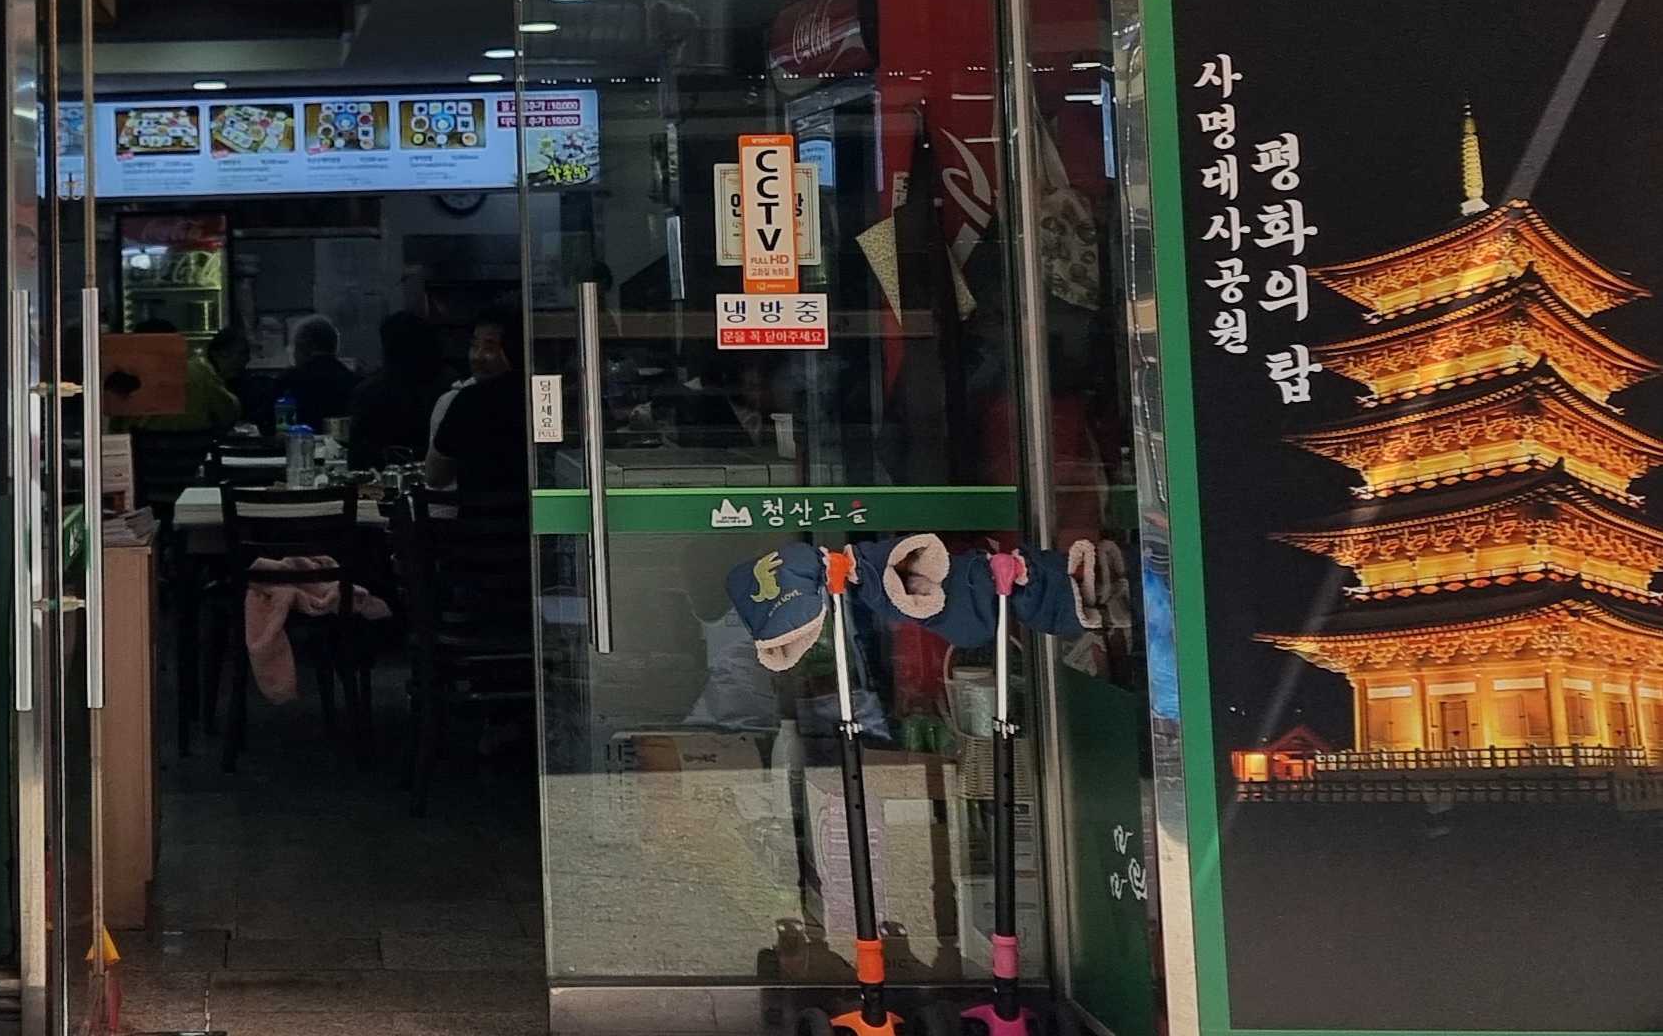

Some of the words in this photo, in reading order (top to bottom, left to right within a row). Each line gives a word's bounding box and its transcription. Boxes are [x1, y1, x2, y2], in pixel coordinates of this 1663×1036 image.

[755, 149, 782, 252] CCTV
[1193, 53, 1251, 354] 사명대사공원
[1251, 133, 1318, 322] 평화의
[750, 257, 768, 265] FULL
[770, 254, 790, 265] HD
[723, 300, 821, 323] 냉방중
[723, 330, 745, 344] 문을
[749, 330, 761, 344] 꼭
[1265, 344, 1323, 404] 탑
[540, 380, 554, 428] 당기세요
[538, 430, 558, 438] PULL
[761, 497, 868, 527] 청산고을
